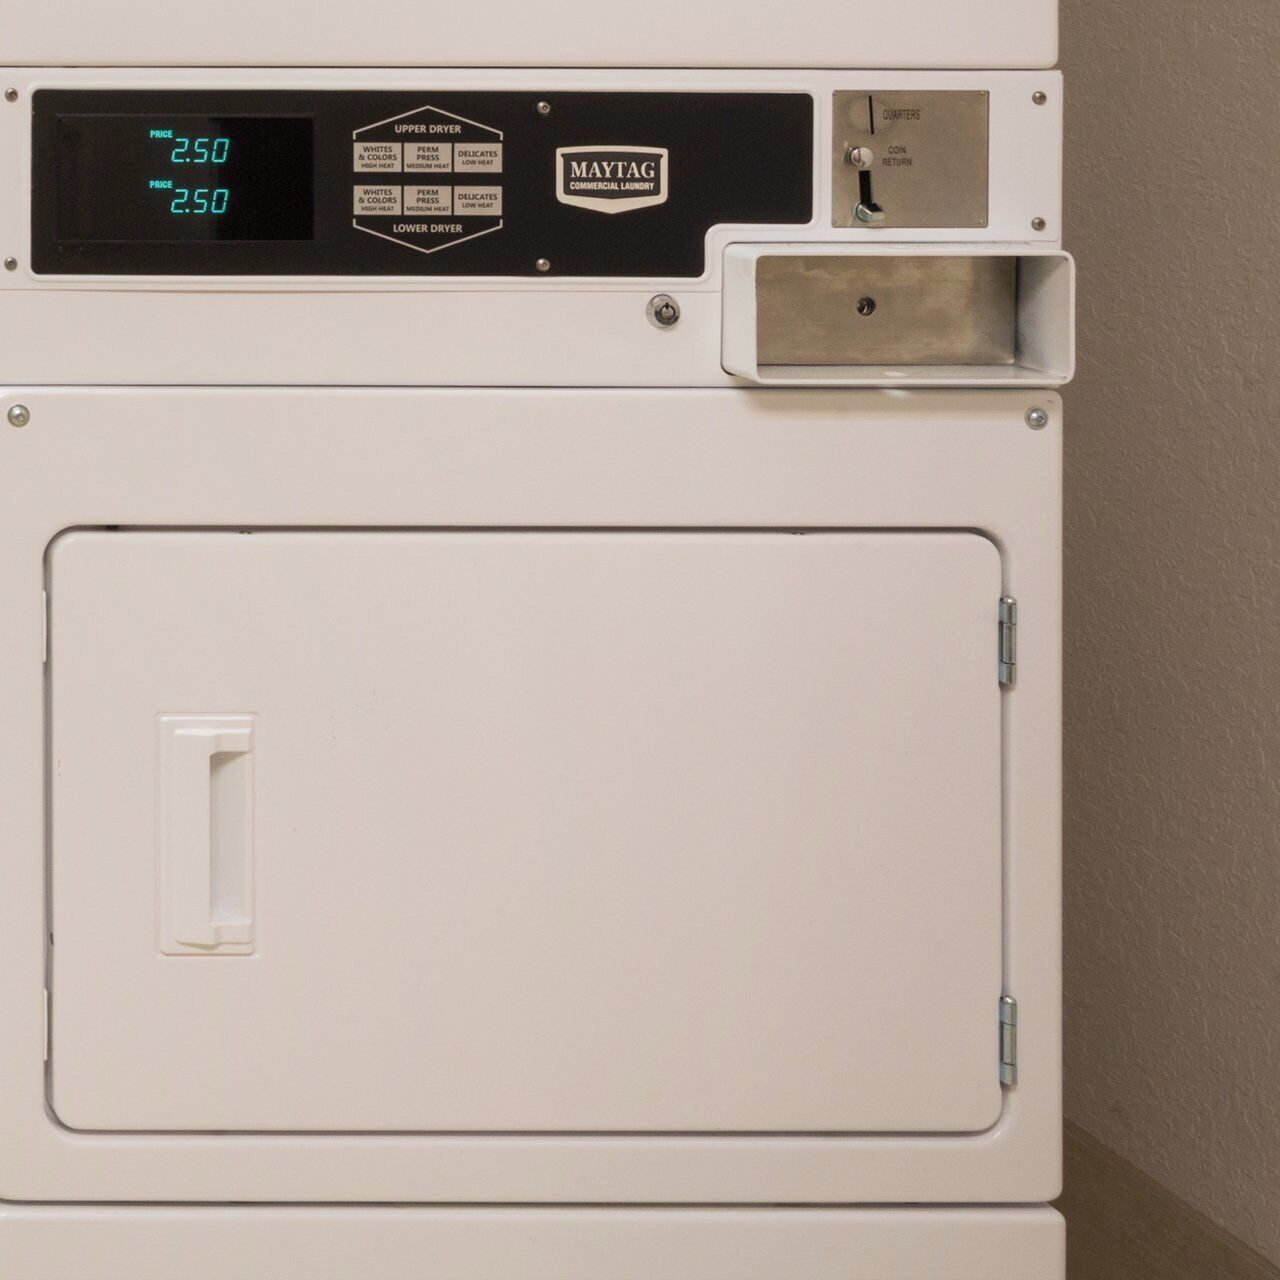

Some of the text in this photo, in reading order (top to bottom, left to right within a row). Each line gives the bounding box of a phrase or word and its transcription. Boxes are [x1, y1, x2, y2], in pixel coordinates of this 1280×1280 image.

[883, 109, 920, 120] QUARTERS
[394, 124, 462, 134] UPPER DRYER
[150, 130, 173, 138] PRICE
[171, 138, 230, 163] 2.50
[888, 146, 906, 154] COIN
[882, 158, 912, 166] RETURN
[570, 161, 655, 178] MAYTAG
[149, 181, 173, 189] PRICE
[569, 181, 655, 190] COMMERCIAL LAUNDRY
[170, 189, 229, 213] 2.50
[393, 224, 462, 233] LOWER DRYER
